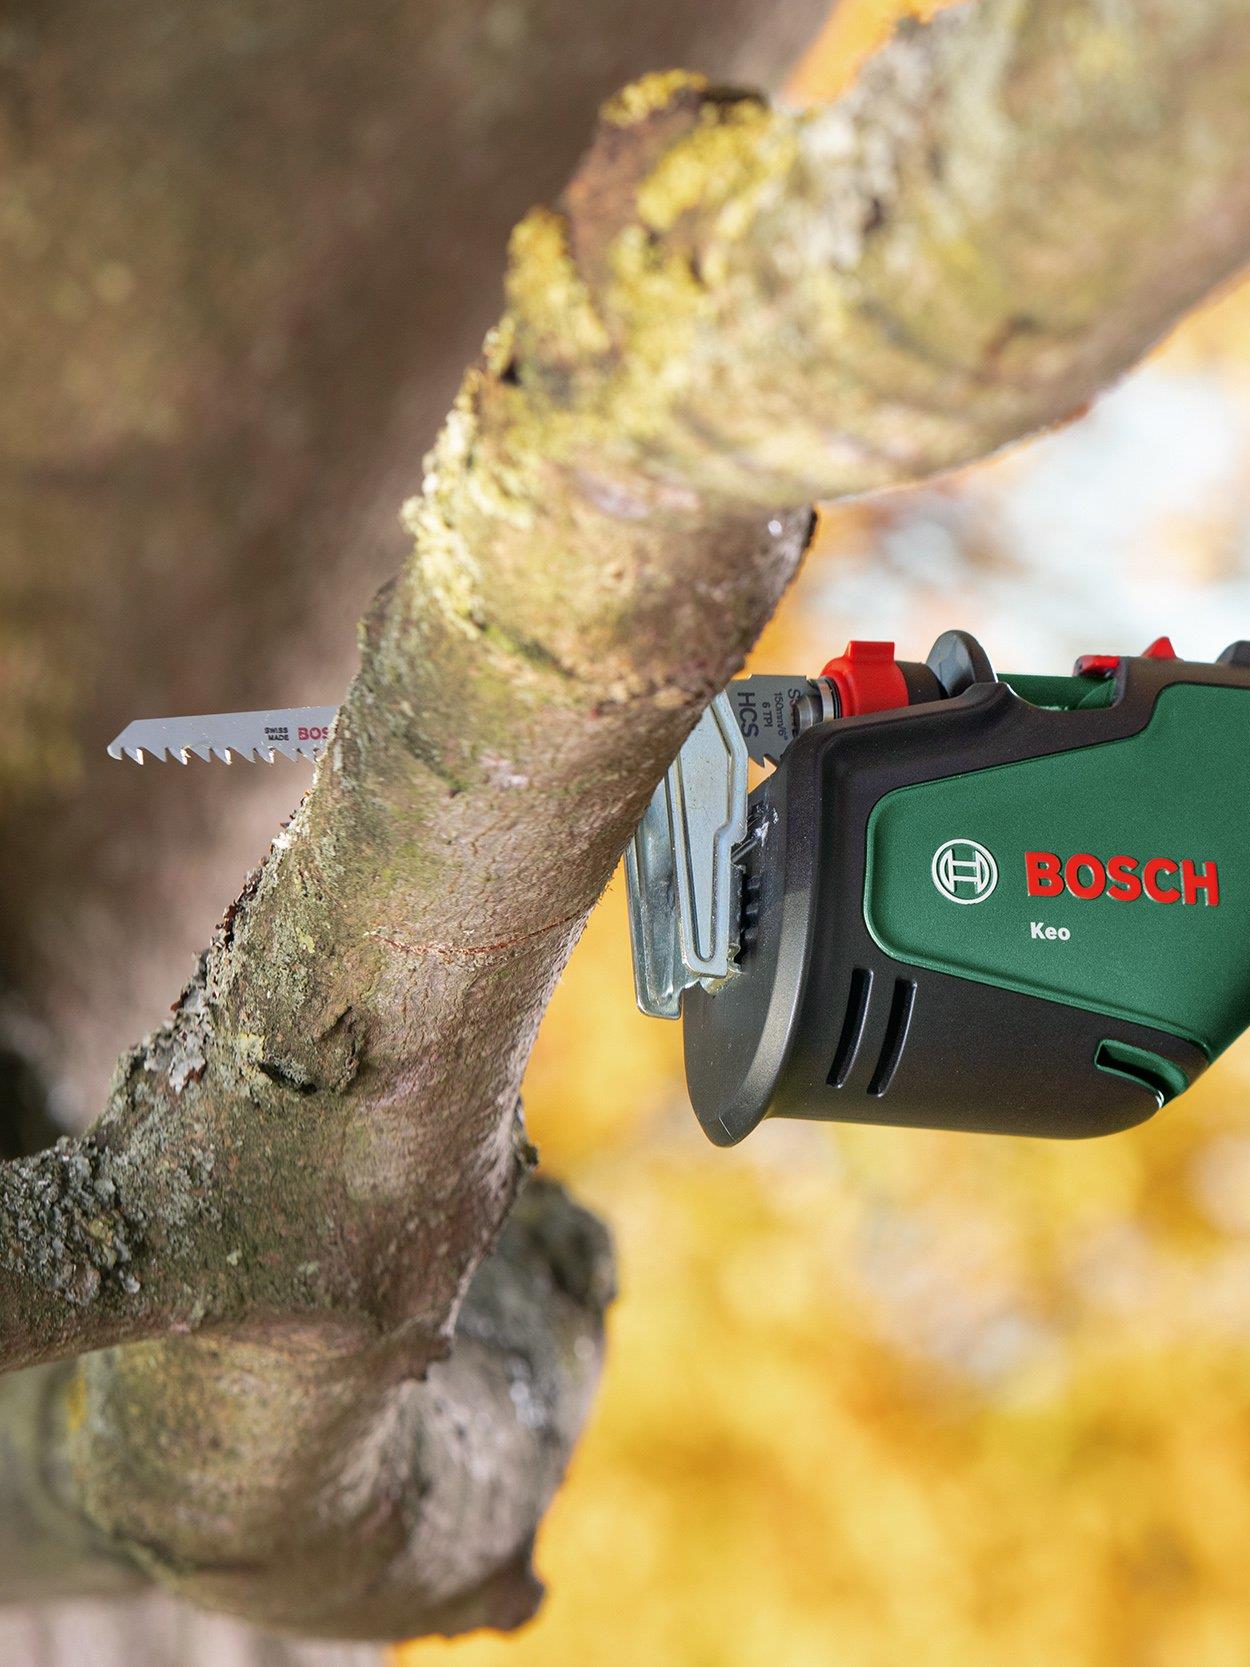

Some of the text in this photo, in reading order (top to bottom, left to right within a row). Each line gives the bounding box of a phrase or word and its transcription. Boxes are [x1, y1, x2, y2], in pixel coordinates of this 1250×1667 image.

[737, 692, 759, 737] HCS
[763, 711, 773, 727] TPI
[1024, 851, 1219, 906] BOSCH
[1030, 922, 1071, 940] Keo
